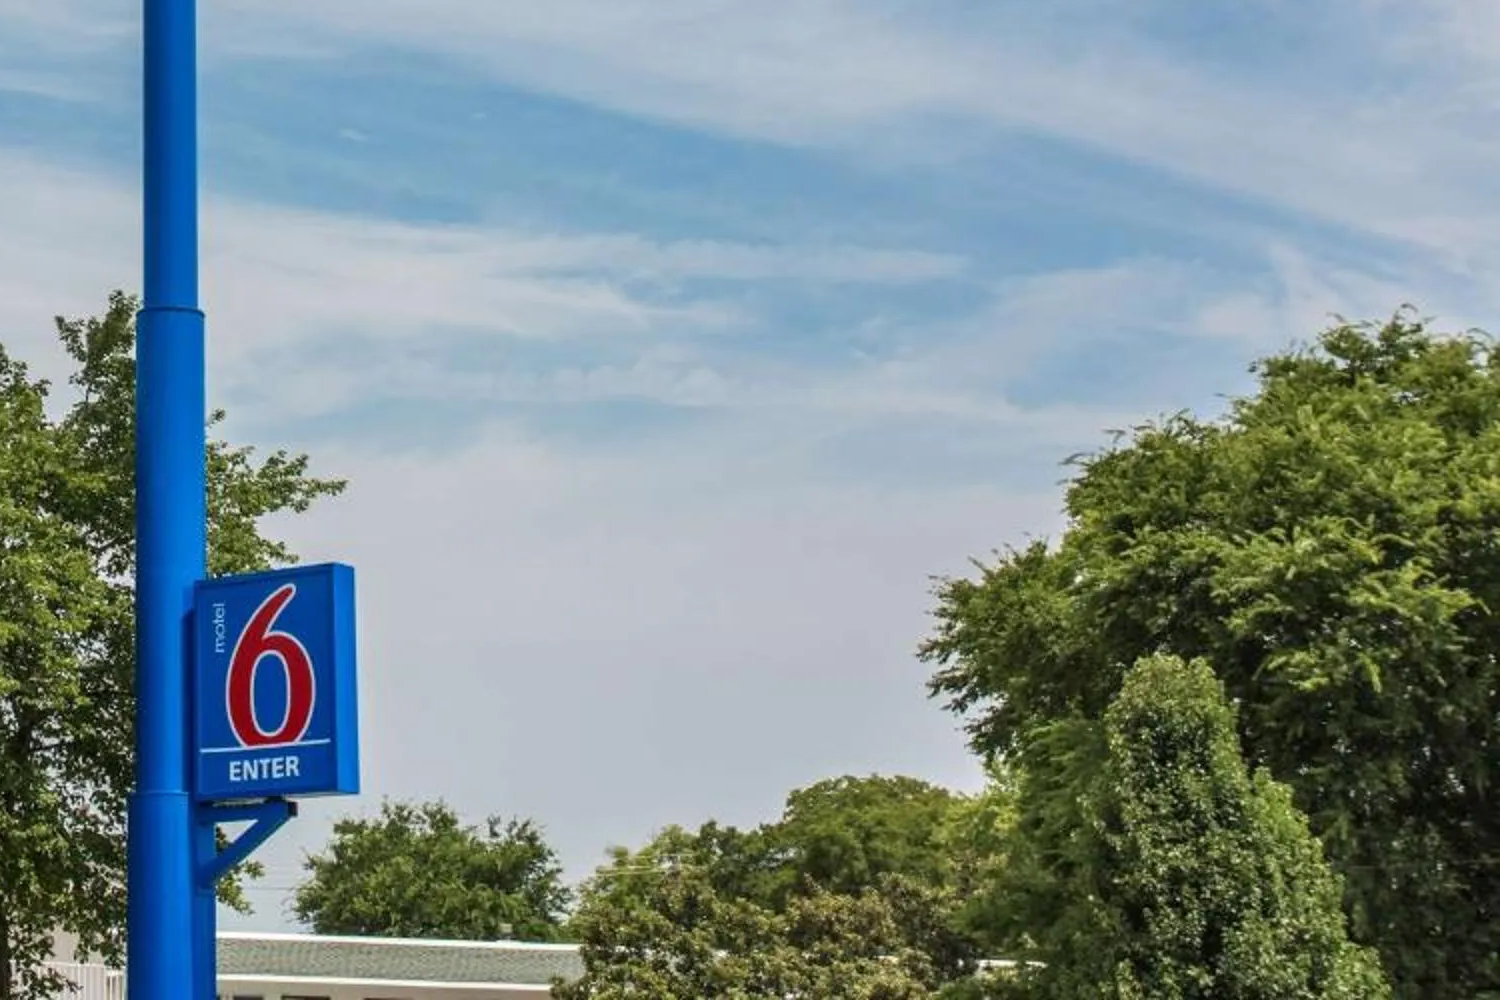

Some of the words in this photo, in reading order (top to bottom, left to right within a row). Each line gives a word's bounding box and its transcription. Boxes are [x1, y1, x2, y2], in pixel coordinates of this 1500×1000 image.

[212, 602, 225, 653] motel
[225, 583, 317, 749] 6
[229, 755, 300, 782] ENTER
